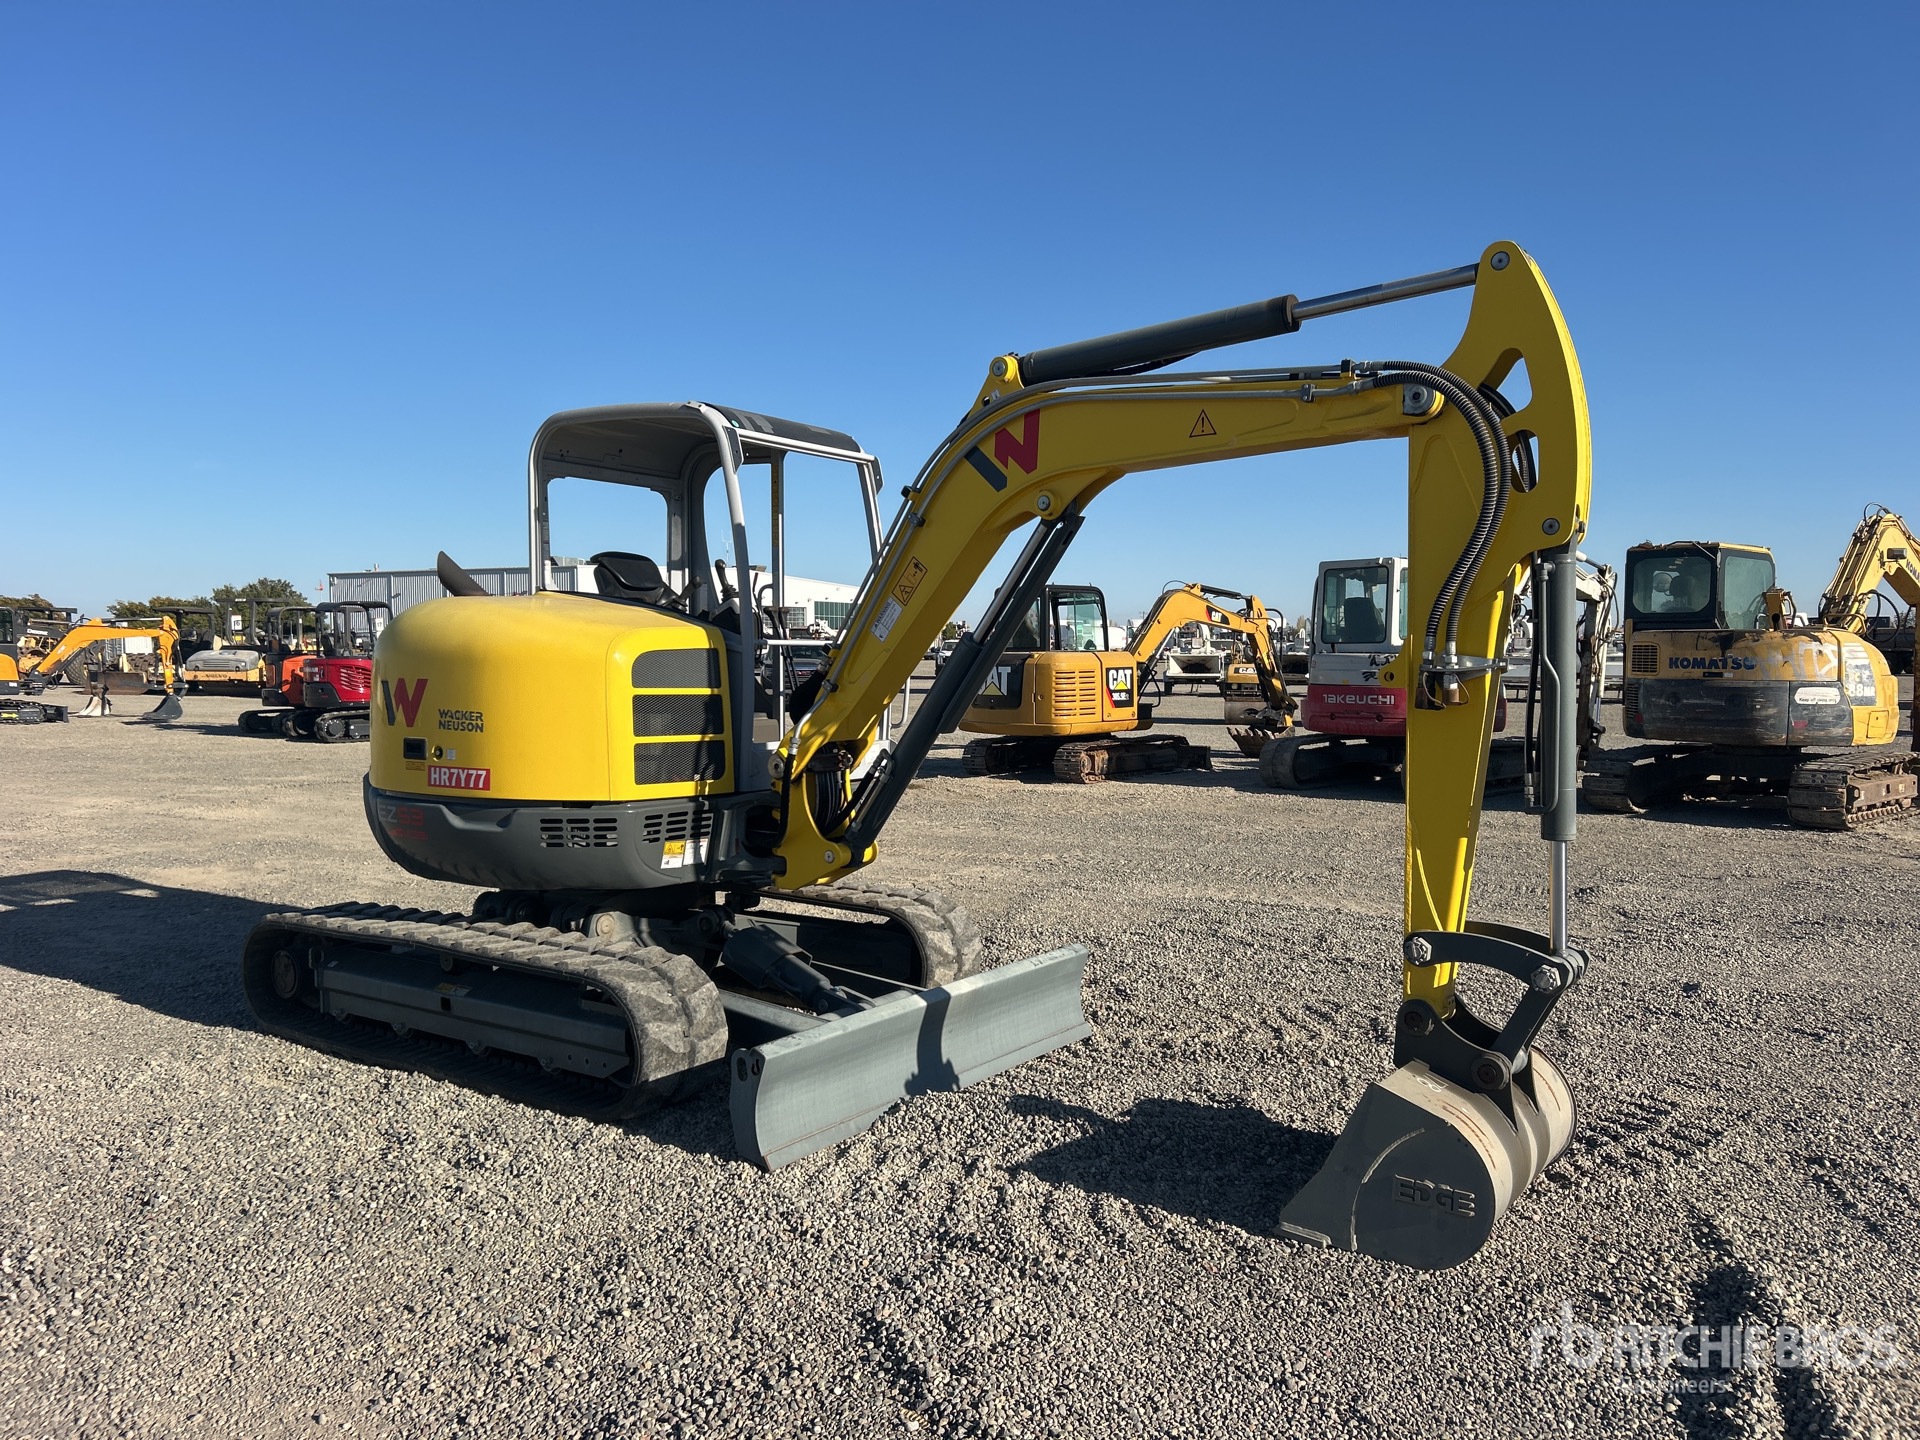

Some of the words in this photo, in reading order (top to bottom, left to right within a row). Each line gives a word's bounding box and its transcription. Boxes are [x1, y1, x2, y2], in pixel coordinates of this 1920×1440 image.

[1211, 611, 1222, 622] CAT
[979, 666, 1012, 696] AT
[1108, 669, 1132, 690] CAT
[438, 708, 485, 722] WACKER
[438, 720, 485, 733] NEUSON
[430, 766, 487, 789] HR7Y77
[1394, 1173, 1476, 1218] EDGE
